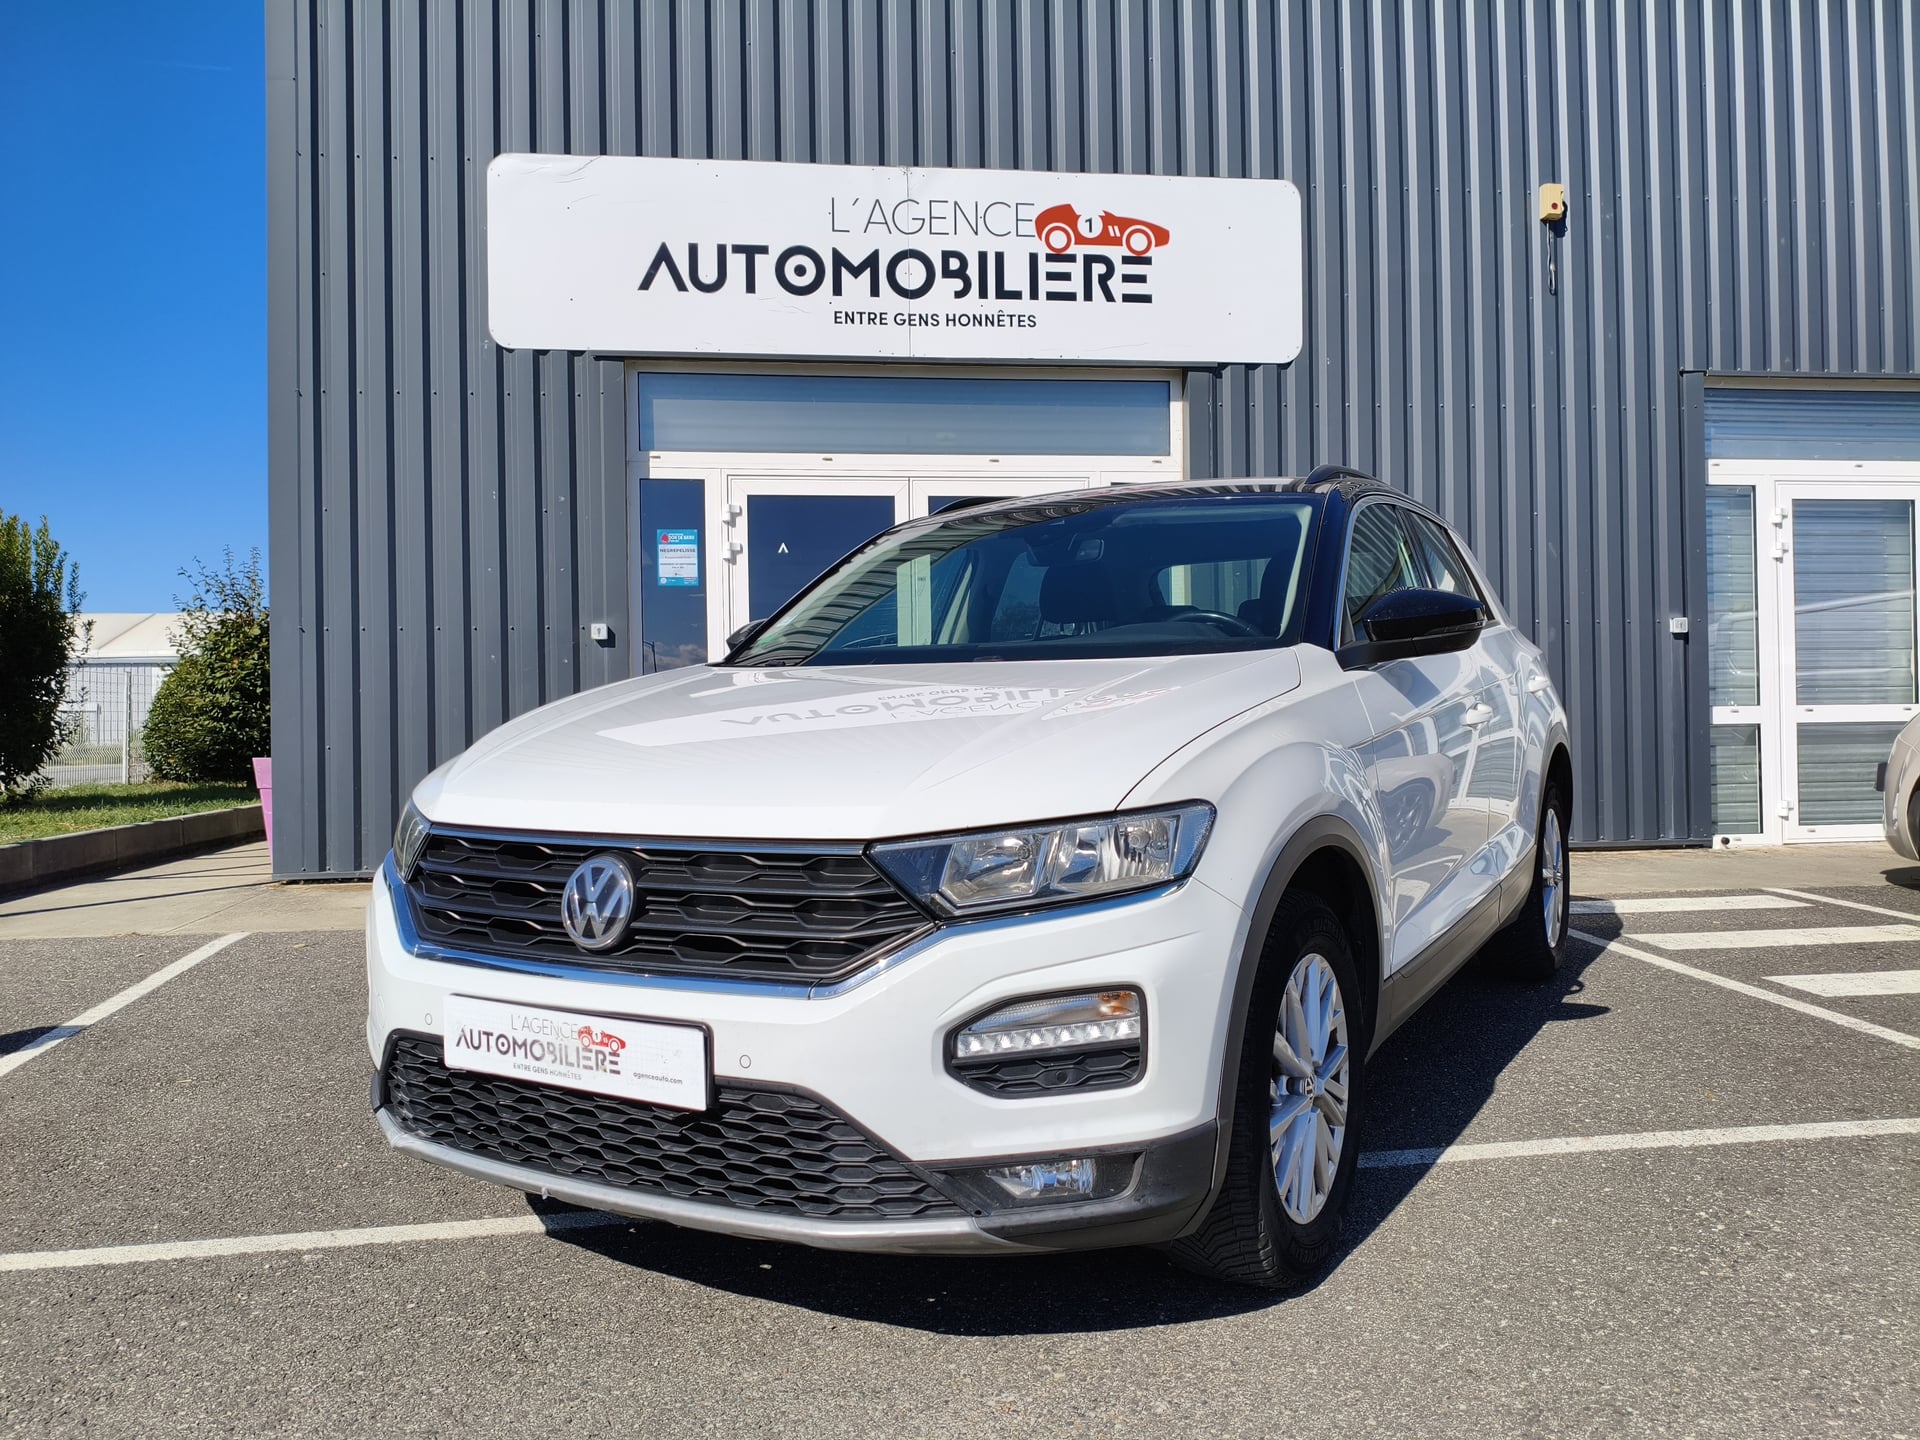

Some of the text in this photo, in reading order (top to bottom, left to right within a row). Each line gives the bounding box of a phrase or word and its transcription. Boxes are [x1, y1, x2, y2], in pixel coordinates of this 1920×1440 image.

[831, 197, 1036, 237] L'AGENCE
[1084, 217, 1094, 233] 1
[637, 241, 1153, 304] AUTOMOBILIERE
[833, 309, 1037, 328] ENTRE GENS HONNÊTES
[511, 1014, 579, 1040] L'AGENCE
[513, 1062, 532, 1073] ENTRE
[532, 1065, 549, 1075] GENS
[633, 1071, 683, 1085] agenceauto.com
